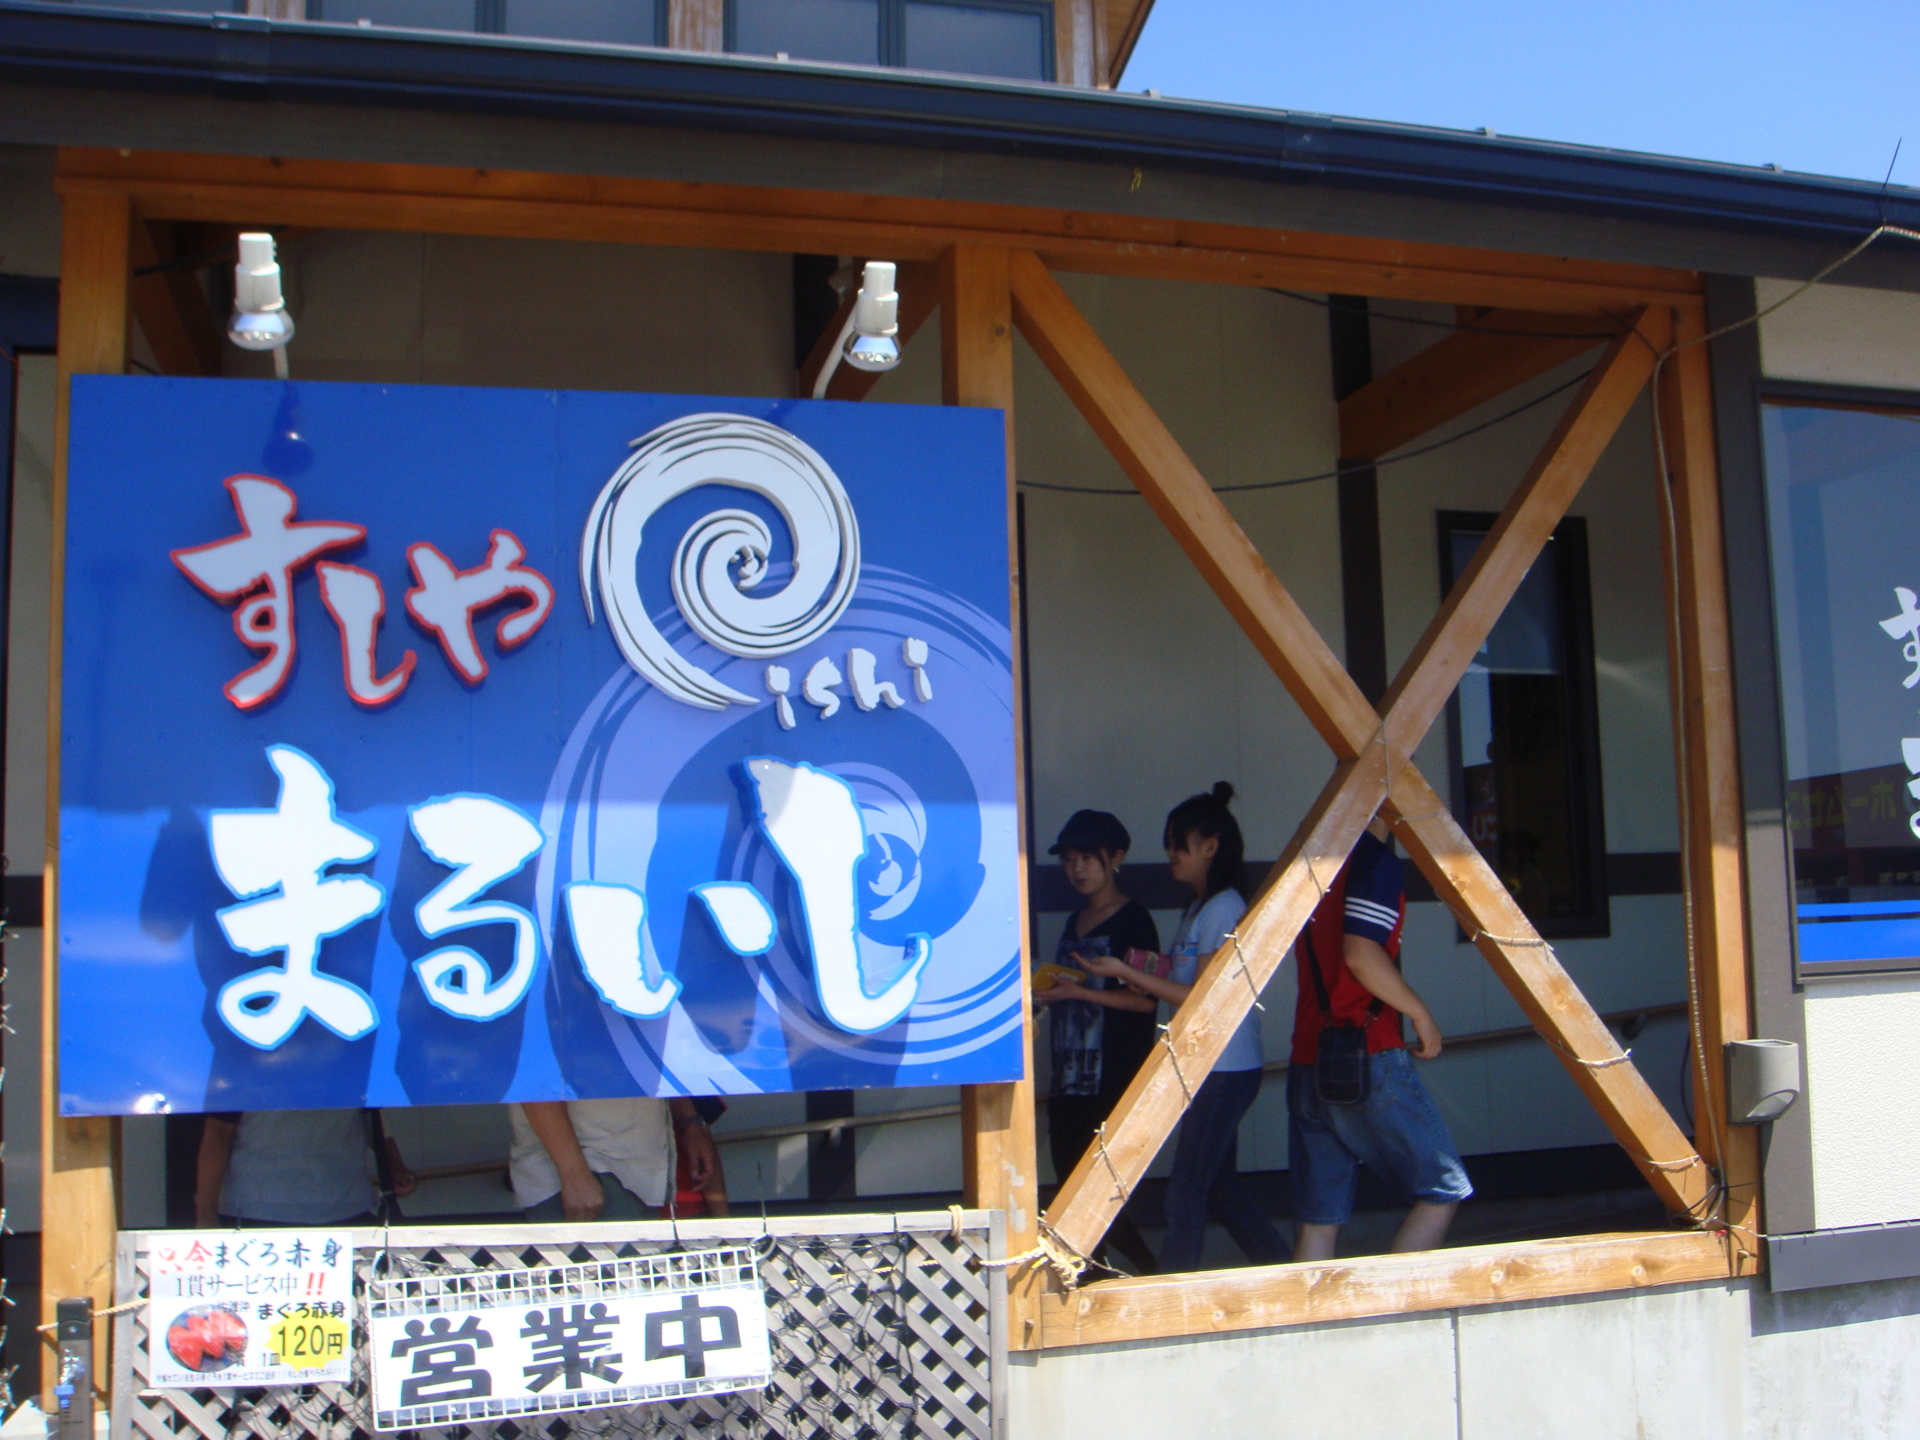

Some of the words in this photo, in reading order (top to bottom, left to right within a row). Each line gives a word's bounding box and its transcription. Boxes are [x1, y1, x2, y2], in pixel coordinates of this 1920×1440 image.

[170, 473, 555, 710] すしや
[207, 743, 933, 1050] まるいし
[258, 1301, 346, 1320] まぐろ赤身
[278, 1324, 343, 1357] 120円
[390, 1294, 743, 1408] 営業中
